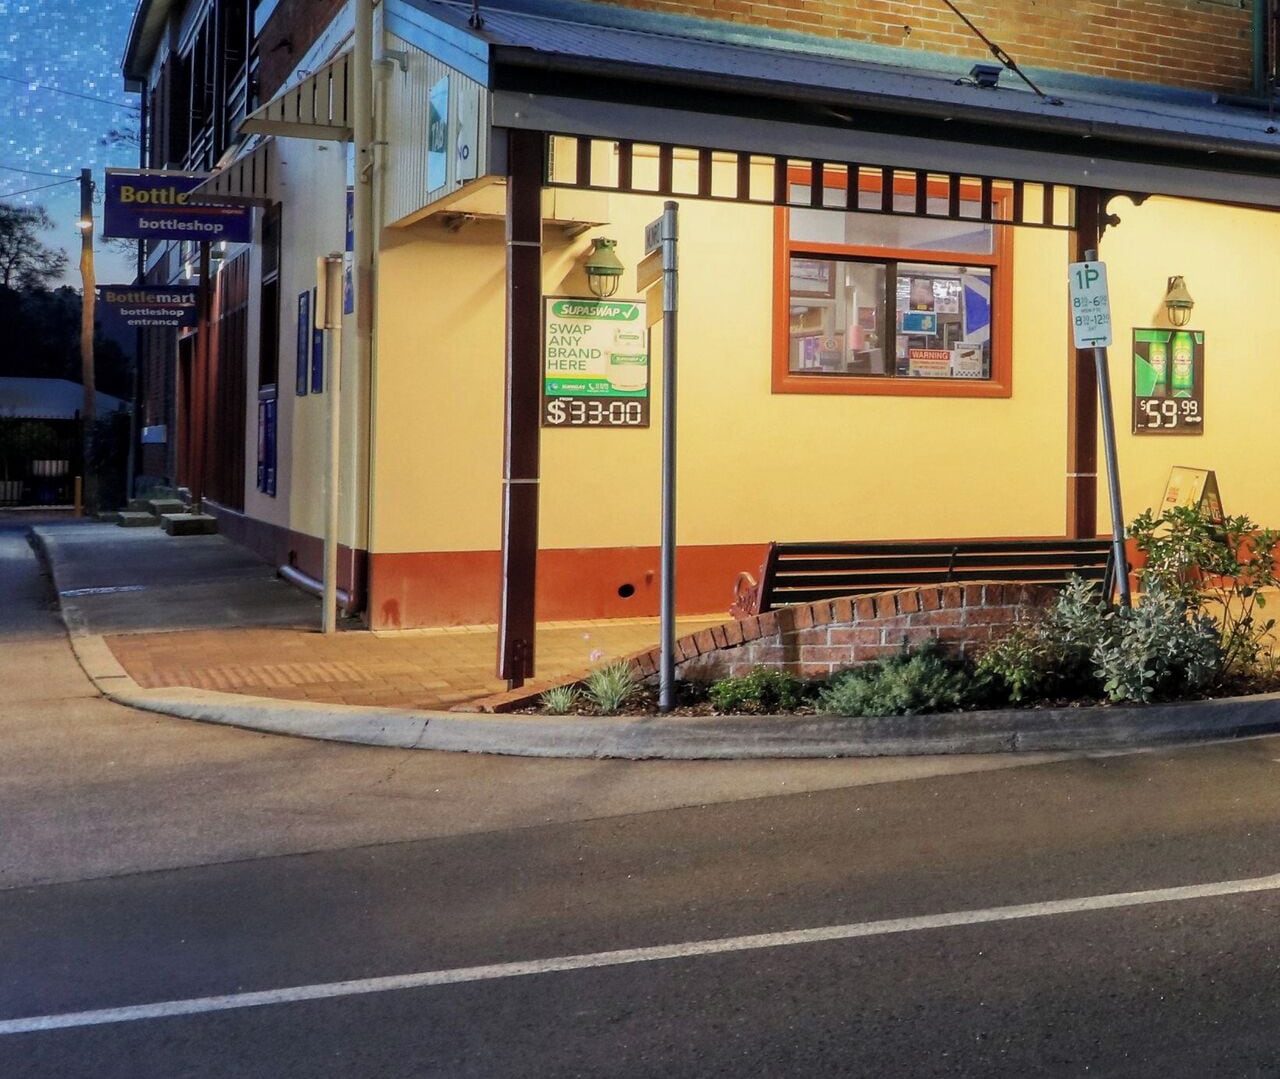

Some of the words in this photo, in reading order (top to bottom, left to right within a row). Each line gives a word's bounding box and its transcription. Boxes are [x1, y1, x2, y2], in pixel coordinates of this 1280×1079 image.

[139, 217, 224, 234] bottleshop
[1076, 269, 1100, 289] 1P
[106, 291, 196, 303] Bottlemart
[120, 307, 185, 318] bottleshop
[560, 304, 620, 318] SUPASWAP
[549, 323, 592, 335] SWAP
[548, 336, 582, 346] ANY
[547, 347, 602, 359] BRAND
[911, 351, 948, 360] WARNING
[547, 360, 587, 371] HERE
